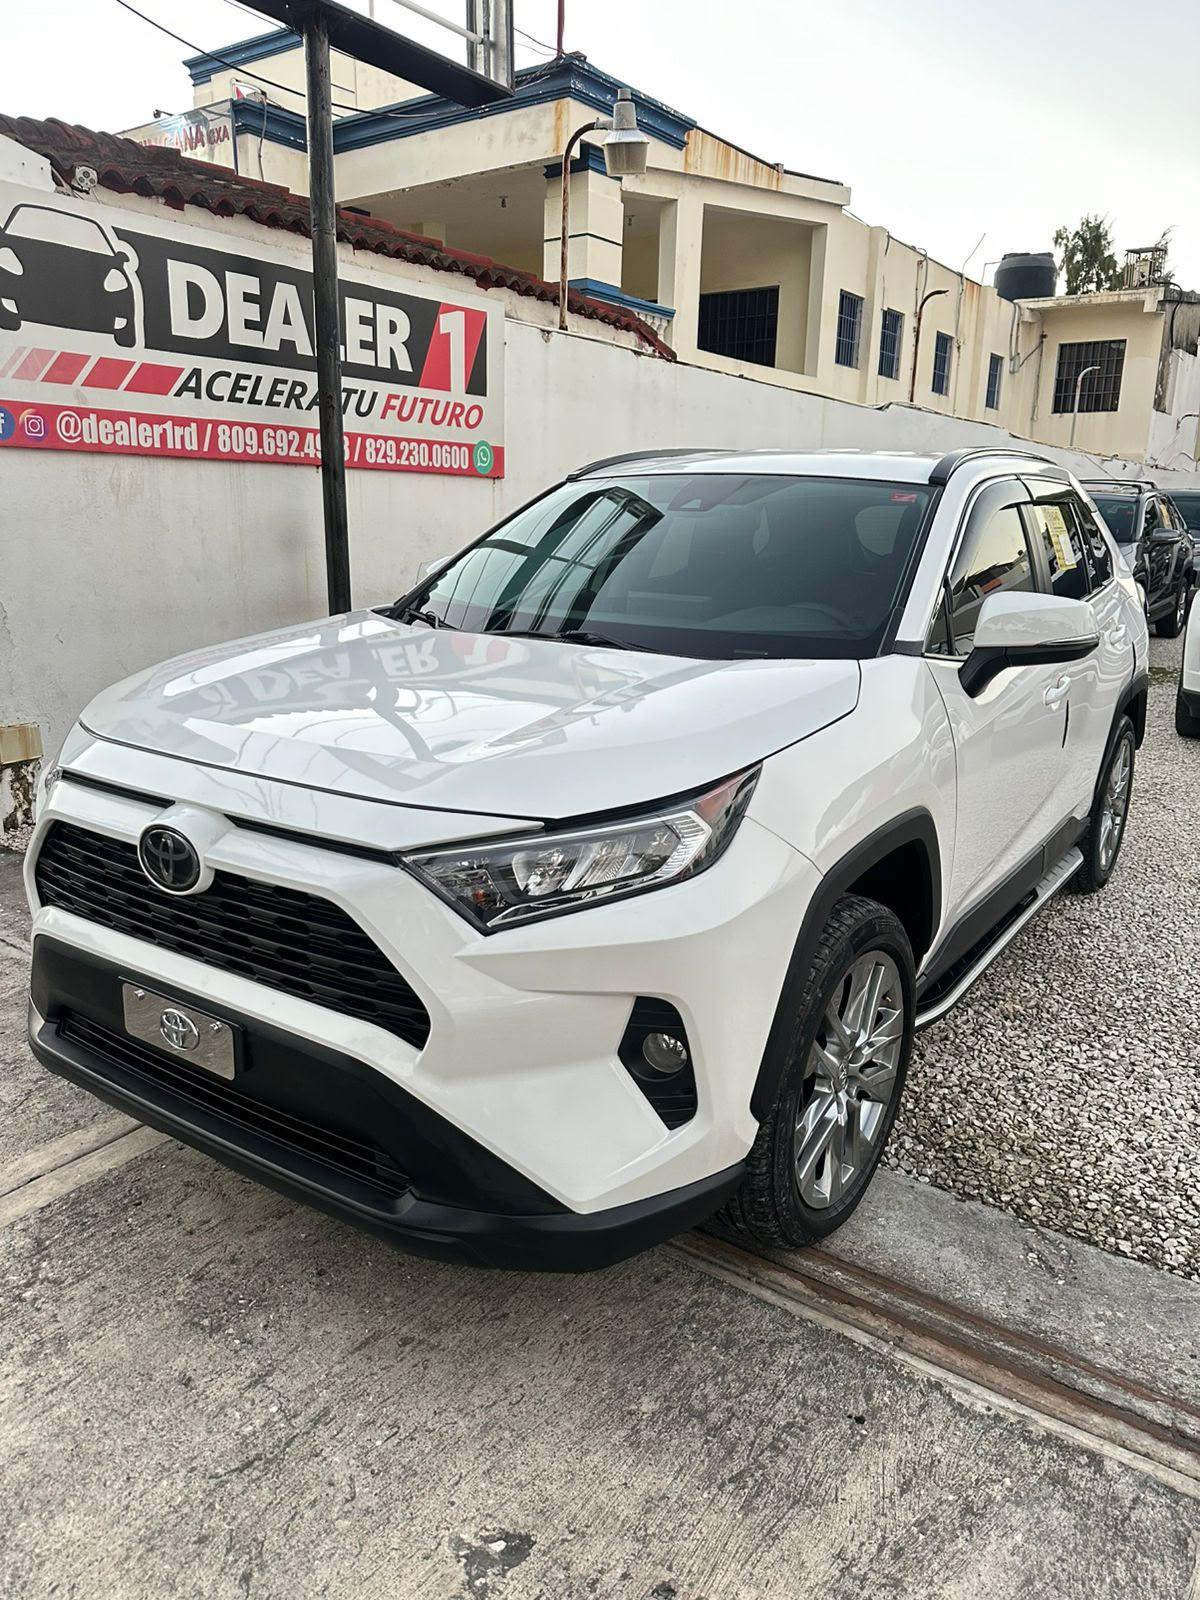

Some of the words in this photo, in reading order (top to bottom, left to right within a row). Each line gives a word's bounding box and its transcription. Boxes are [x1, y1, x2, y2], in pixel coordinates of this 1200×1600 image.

[167, 258, 414, 372] DEAER
[439, 310, 467, 395] 1
[341, 387, 378, 418] TU
[380, 393, 484, 430] FUTURO
[56, 410, 199, 451] @dealer1rd
[217, 424, 350, 462] 809.692.4
[365, 437, 469, 469] 829.230.0600
